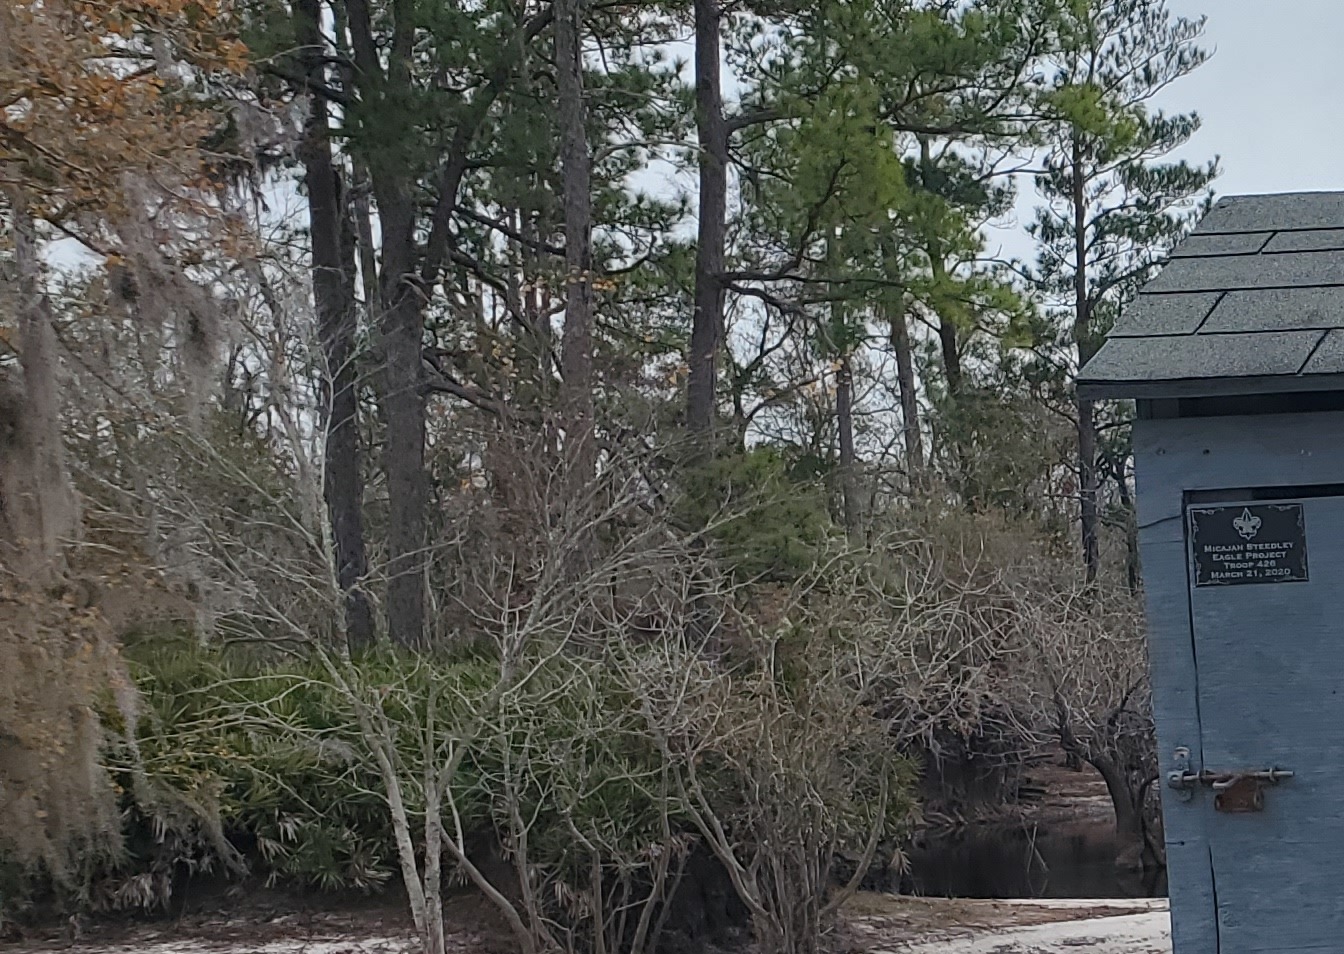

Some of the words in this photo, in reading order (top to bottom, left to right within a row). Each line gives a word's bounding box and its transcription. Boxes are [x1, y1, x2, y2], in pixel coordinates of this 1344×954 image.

[1246, 542, 1293, 550] STEEDLEY
[1212, 553, 1243, 561] EAGLE
[1245, 551, 1287, 559] PROJECT
[1224, 561, 1255, 569] TROOP
[1211, 571, 1243, 579] MARCH
[1246, 569, 1262, 578] 21,
[1265, 568, 1291, 576] 2020
